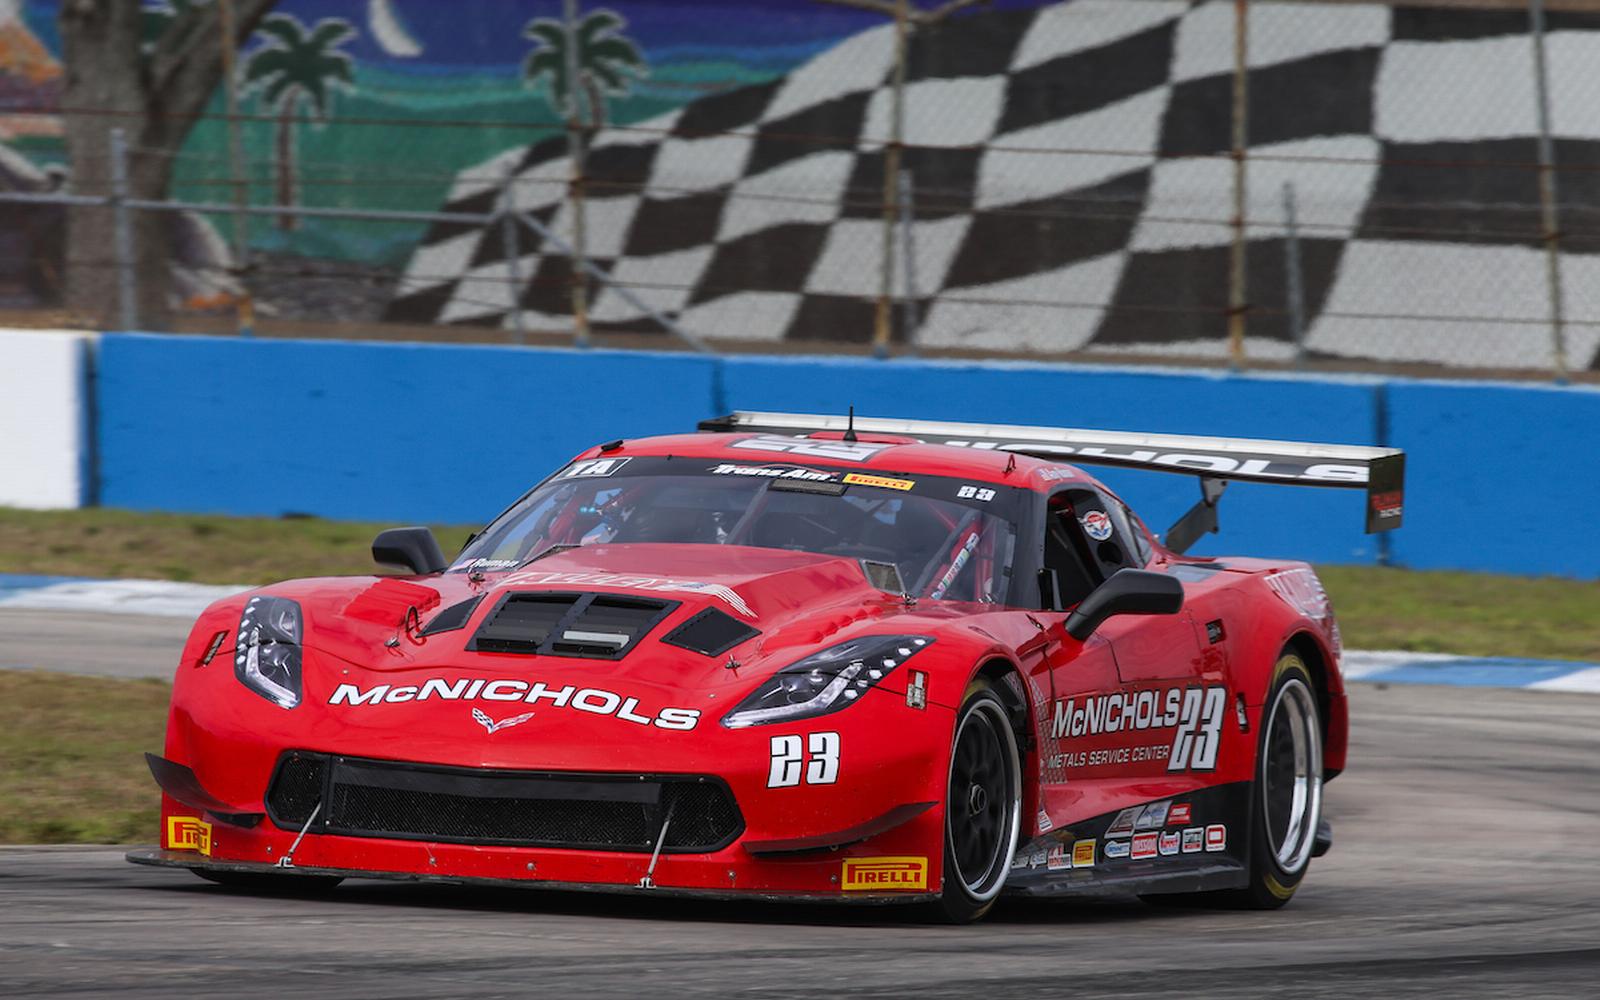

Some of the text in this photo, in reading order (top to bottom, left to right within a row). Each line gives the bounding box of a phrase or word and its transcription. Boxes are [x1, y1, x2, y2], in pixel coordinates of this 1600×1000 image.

[565, 460, 616, 477] TA
[711, 464, 831, 482] Trans Am
[849, 475, 909, 489] PIRELLI
[328, 678, 702, 731] McNICHOLS
[1051, 687, 1181, 740] McNICHOLS
[1168, 686, 1226, 772] 23
[767, 732, 840, 789] 23
[1049, 745, 1170, 769] METALS SERVICE CENTER
[847, 863, 922, 884] PIRELLI
